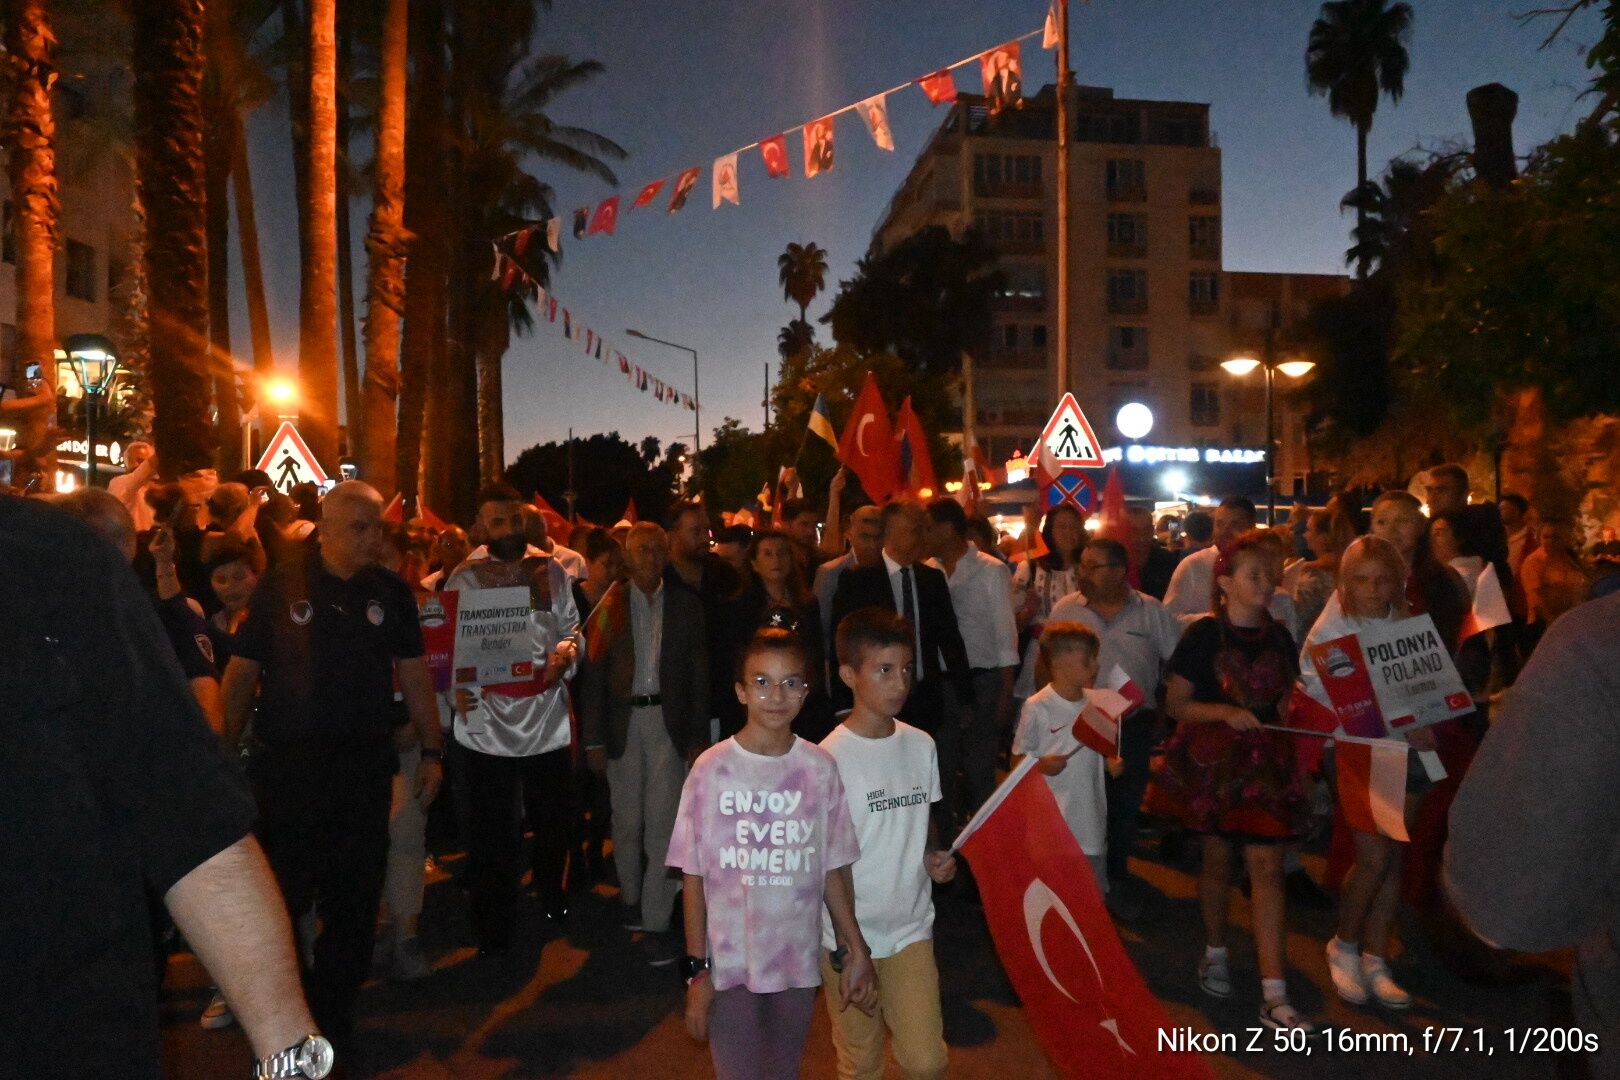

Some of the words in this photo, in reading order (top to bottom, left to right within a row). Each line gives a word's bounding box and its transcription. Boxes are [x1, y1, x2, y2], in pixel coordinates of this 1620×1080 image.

[461, 621, 528, 637] TRANSNISTRIA
[1367, 630, 1438, 664] POLONYA
[1382, 652, 1443, 684] POLAND
[719, 790, 802, 816] ENJOY
[866, 788, 886, 800] HIGH
[868, 792, 929, 813] TECHNOLOGY
[735, 819, 814, 846] EVERY
[719, 846, 816, 874] MOMENT
